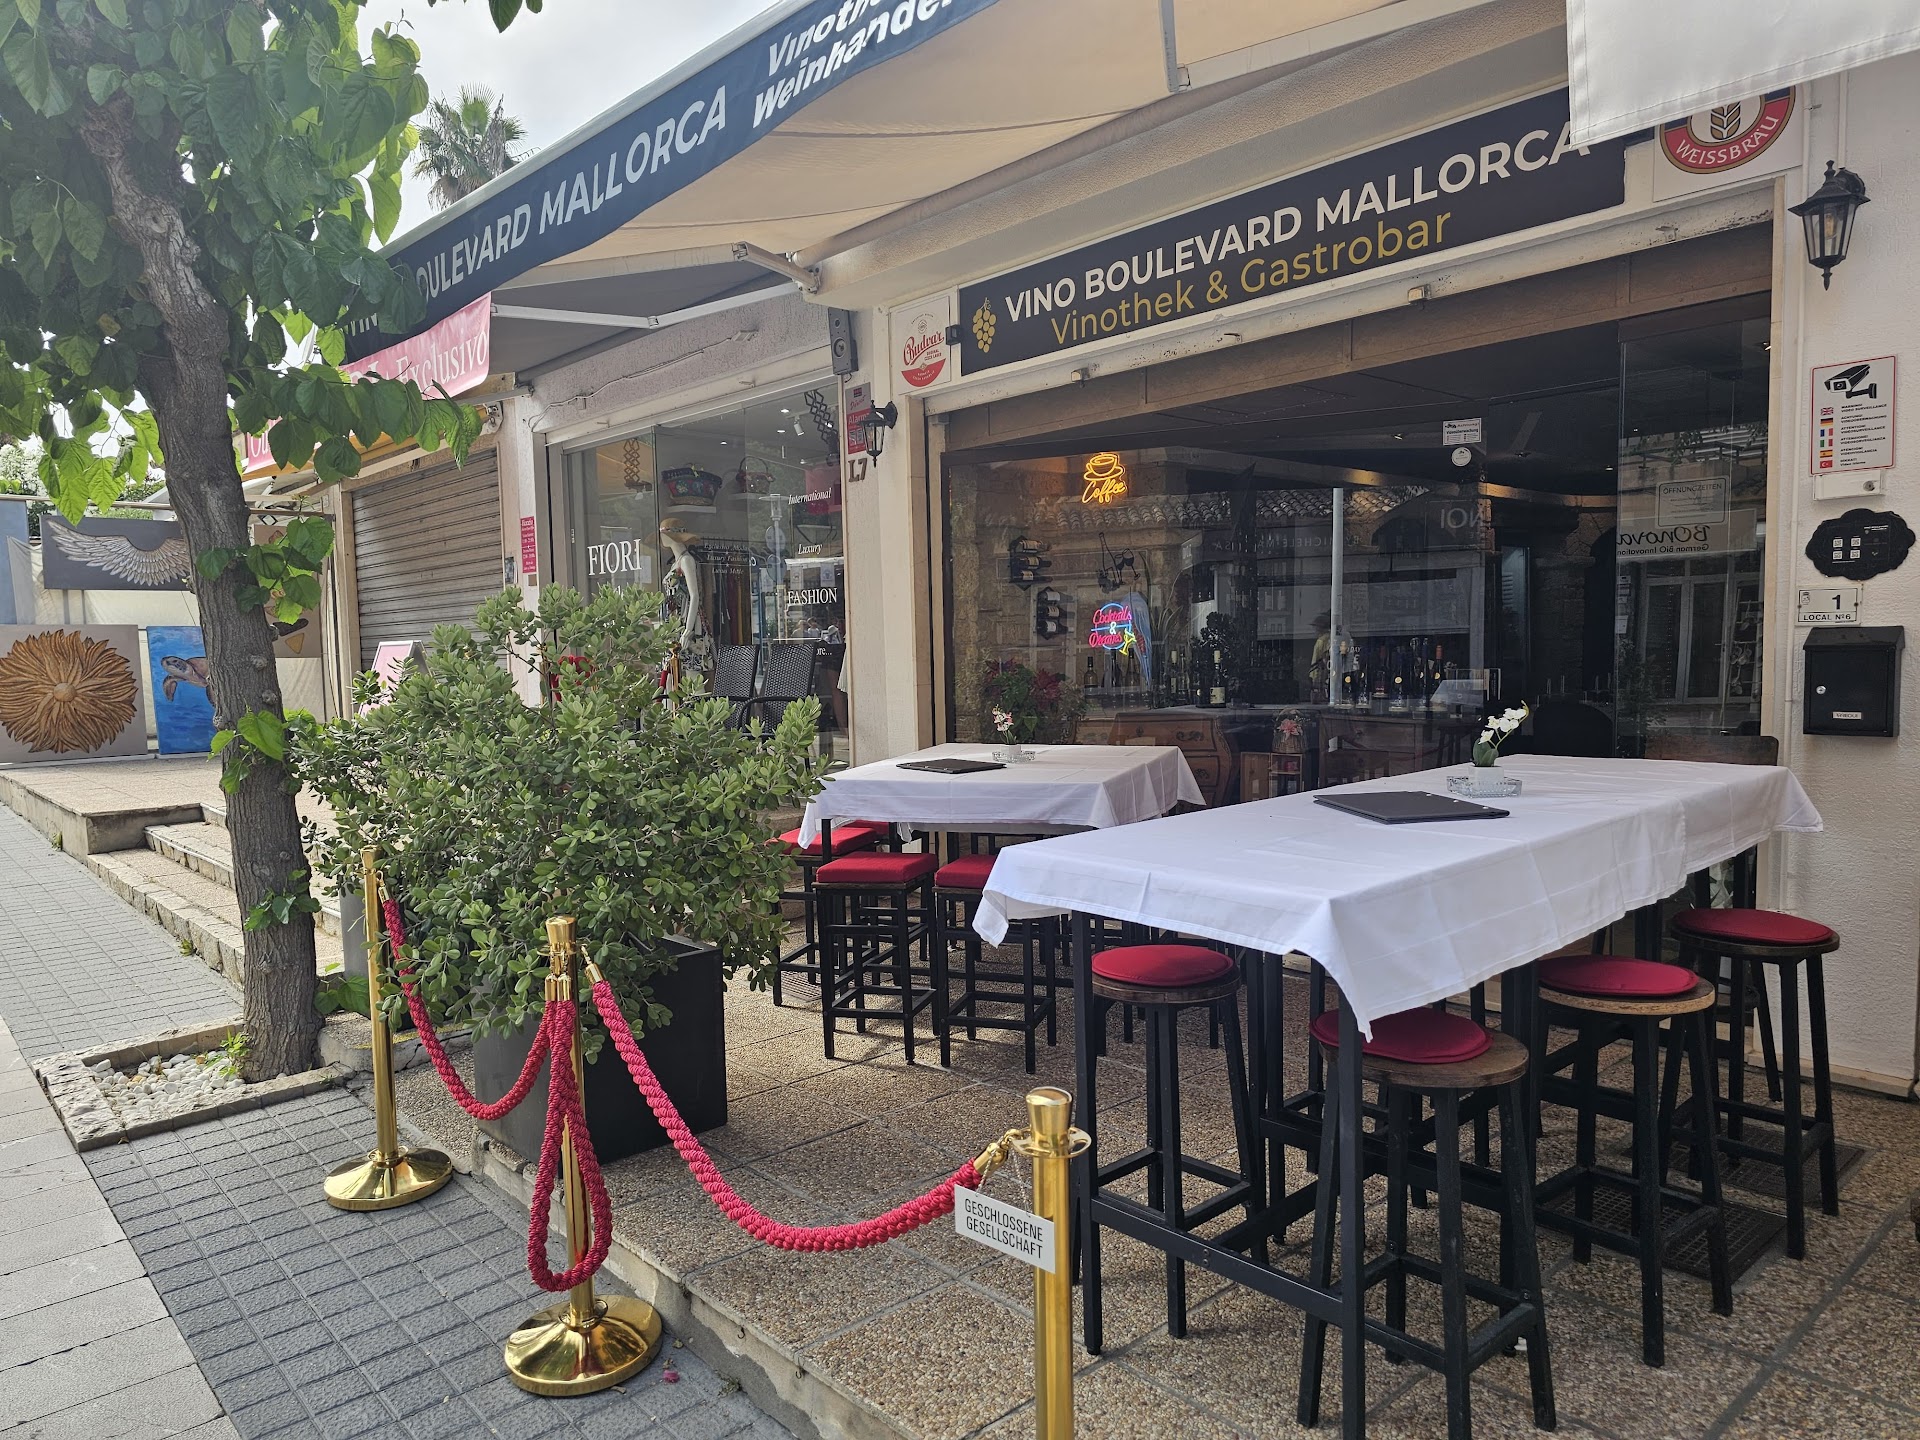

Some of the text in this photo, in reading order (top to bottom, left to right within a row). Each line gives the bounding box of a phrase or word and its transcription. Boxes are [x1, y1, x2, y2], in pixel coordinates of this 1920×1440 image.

[753, 0, 951, 129] Weinhande
[1676, 115, 1780, 165] WEISSBRÄU
[415, 85, 726, 302] OULEVARD MALLORCA
[1005, 277, 1076, 322] VINO
[1085, 206, 1302, 300] BOULEVARD
[1051, 212, 1451, 345] Vinothek & Gastrobar
[847, 457, 868, 483] L7
[788, 487, 832, 505] International
[1082, 478, 1126, 503] Coffee
[587, 538, 643, 576] FIORI
[798, 543, 823, 556] Luxury
[787, 587, 838, 606] FASHION
[1831, 594, 1841, 610] 1
[1109, 621, 1117, 635] &
[1803, 613, 1832, 621] LOCAL
[964, 1198, 1044, 1243] GESCHLOSSENE
[966, 1216, 1044, 1260] GESELLSCHAFT
